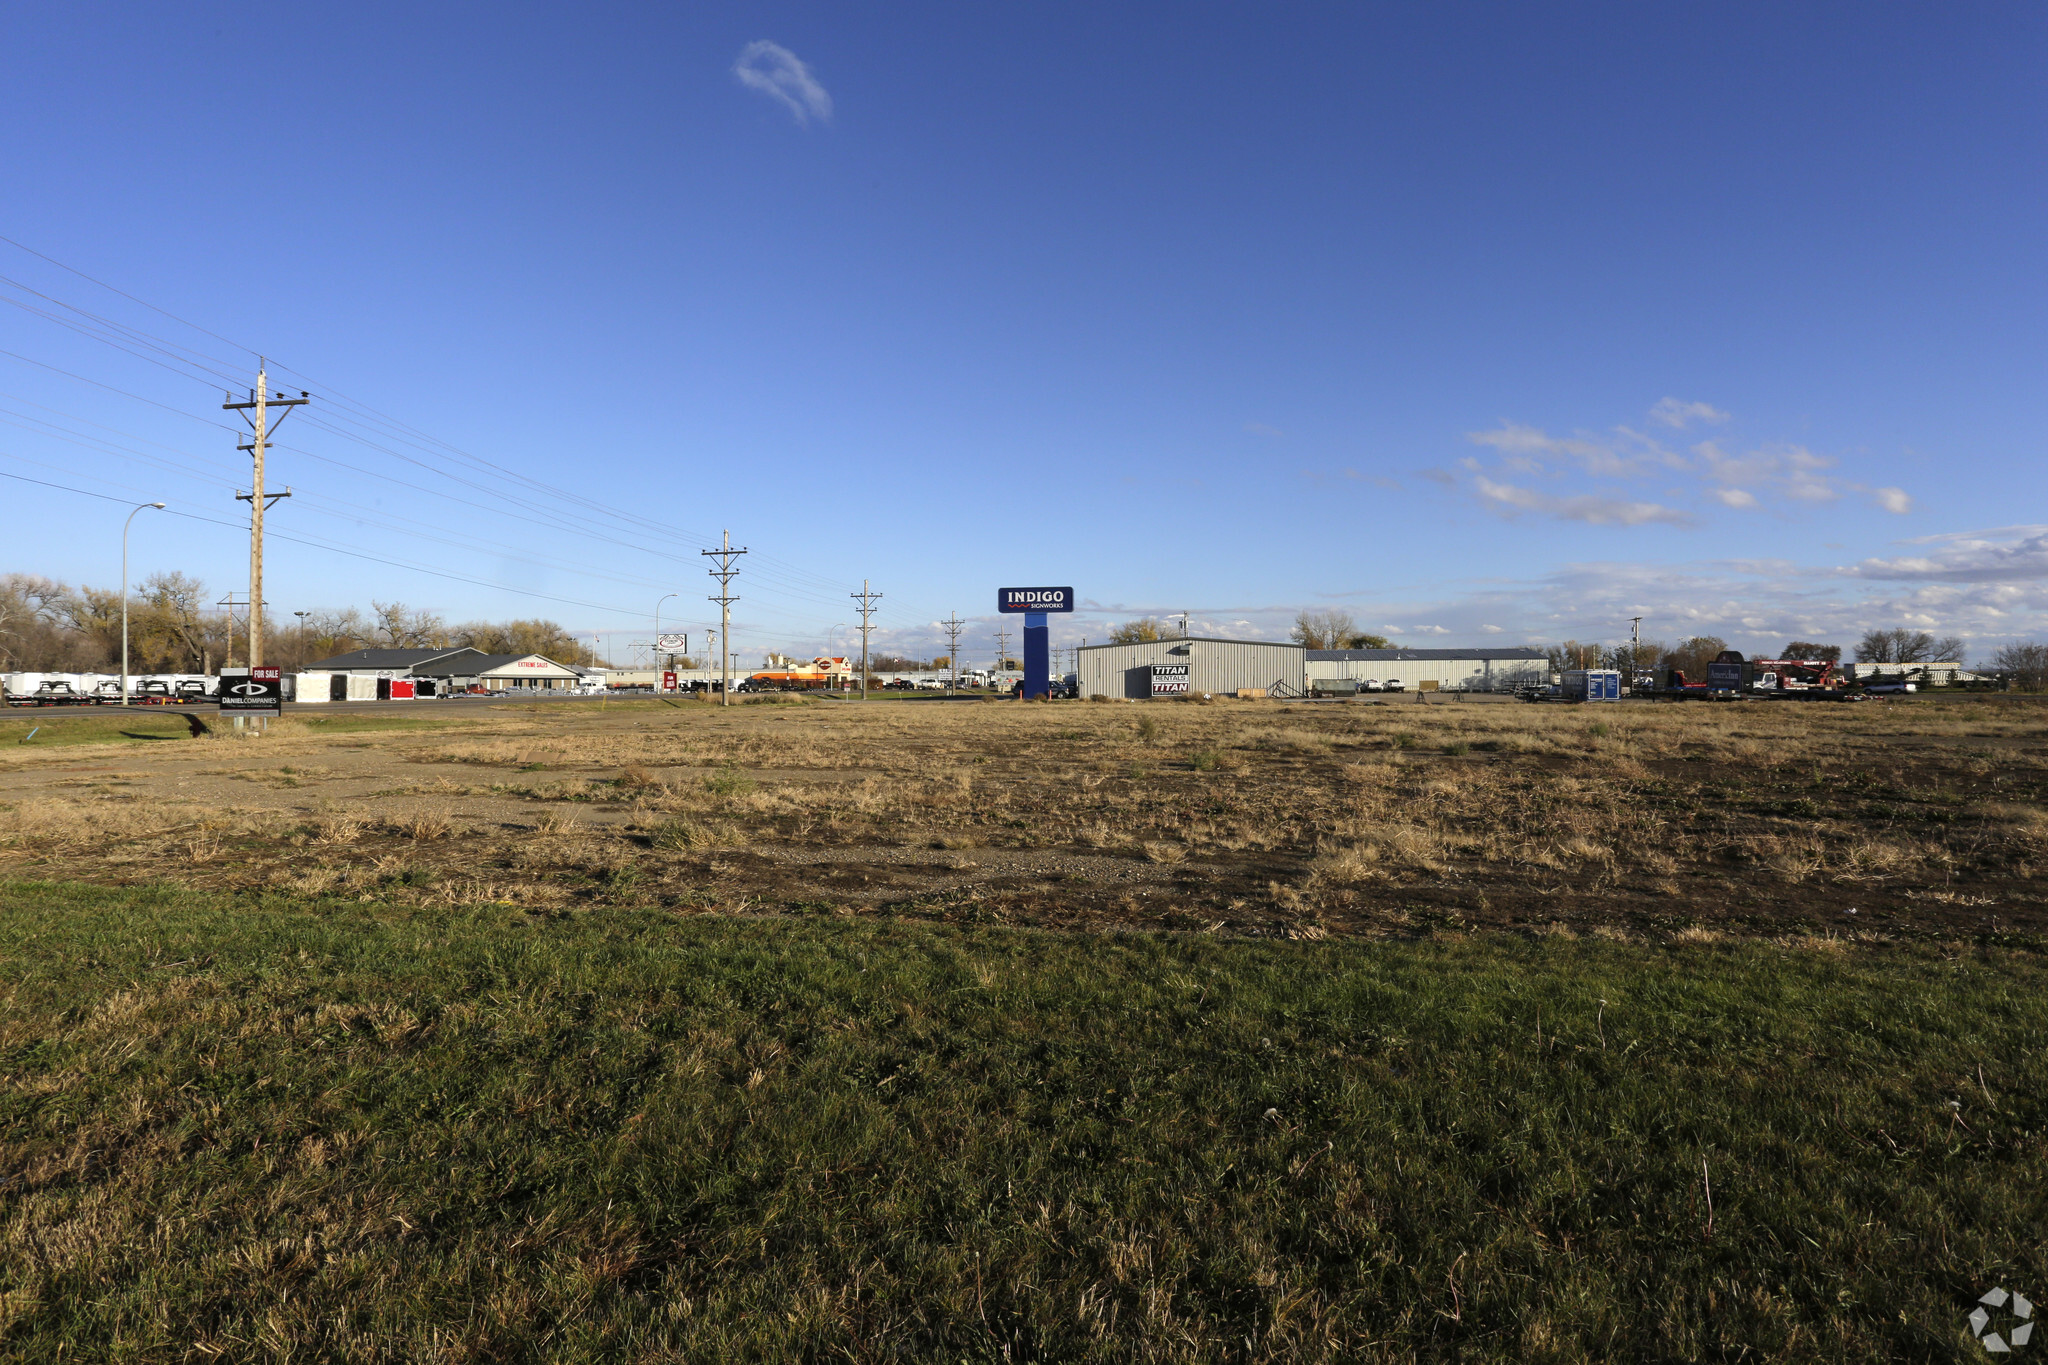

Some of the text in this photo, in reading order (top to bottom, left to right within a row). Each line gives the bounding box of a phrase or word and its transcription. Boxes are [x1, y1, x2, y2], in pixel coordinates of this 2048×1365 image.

[1008, 591, 1064, 602] INDIGO
[254, 670, 279, 678] FOR SALE
